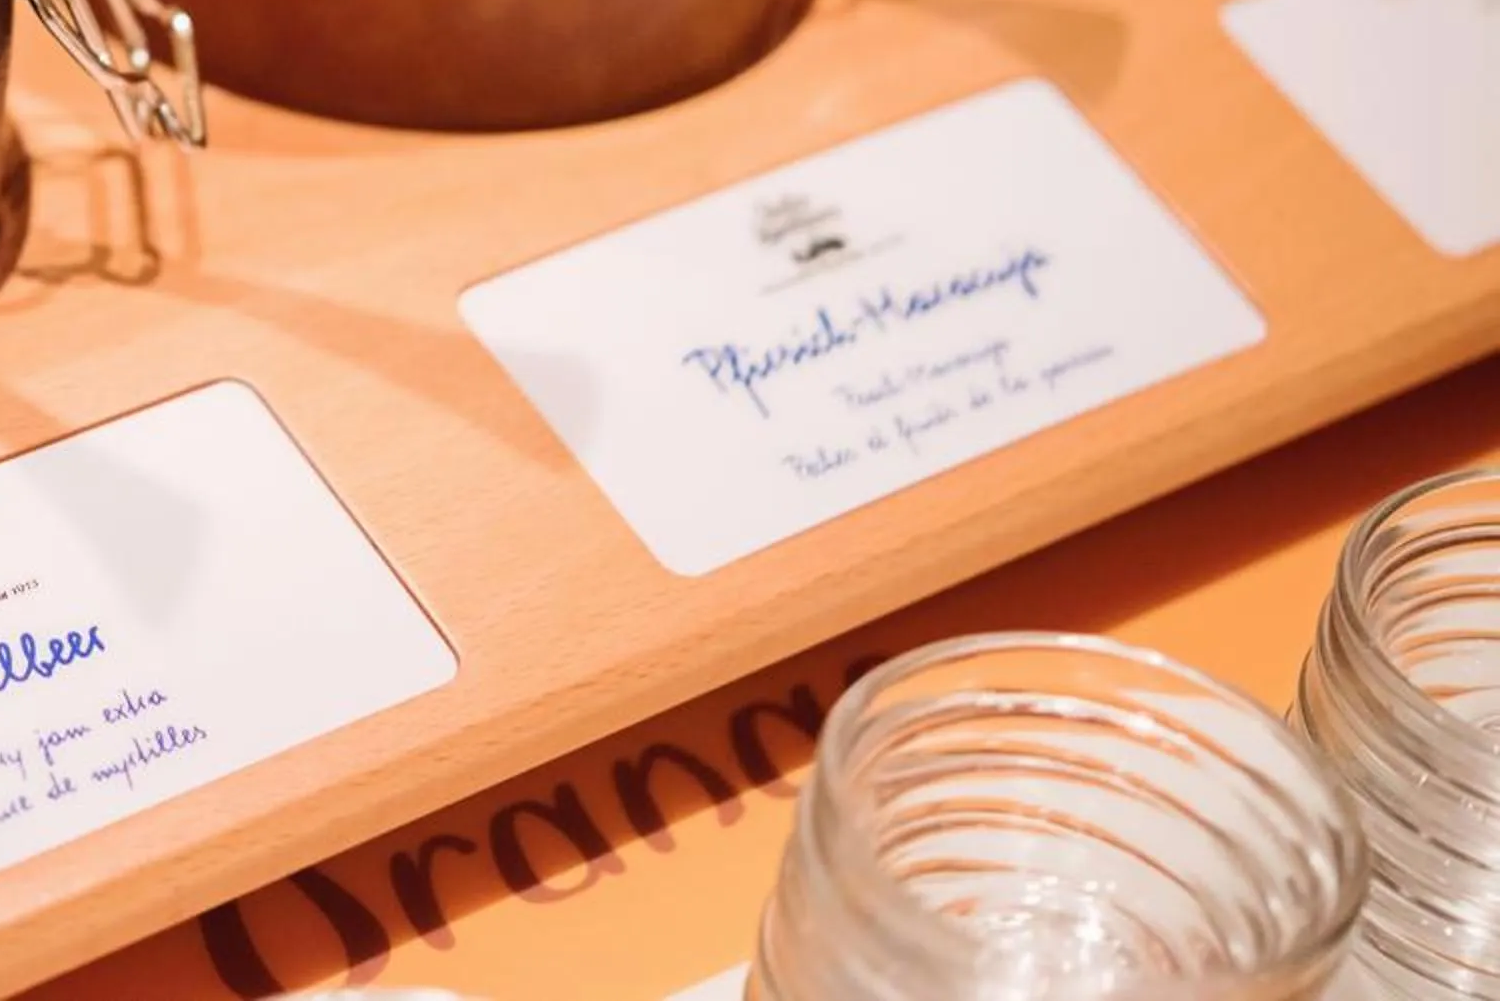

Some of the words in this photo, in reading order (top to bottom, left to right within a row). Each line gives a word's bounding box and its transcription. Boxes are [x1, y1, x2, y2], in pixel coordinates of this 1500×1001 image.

[37, 723, 92, 766] jam
[102, 690, 168, 724] extra
[47, 772, 78, 801] de
[199, 654, 890, 998] Oran
